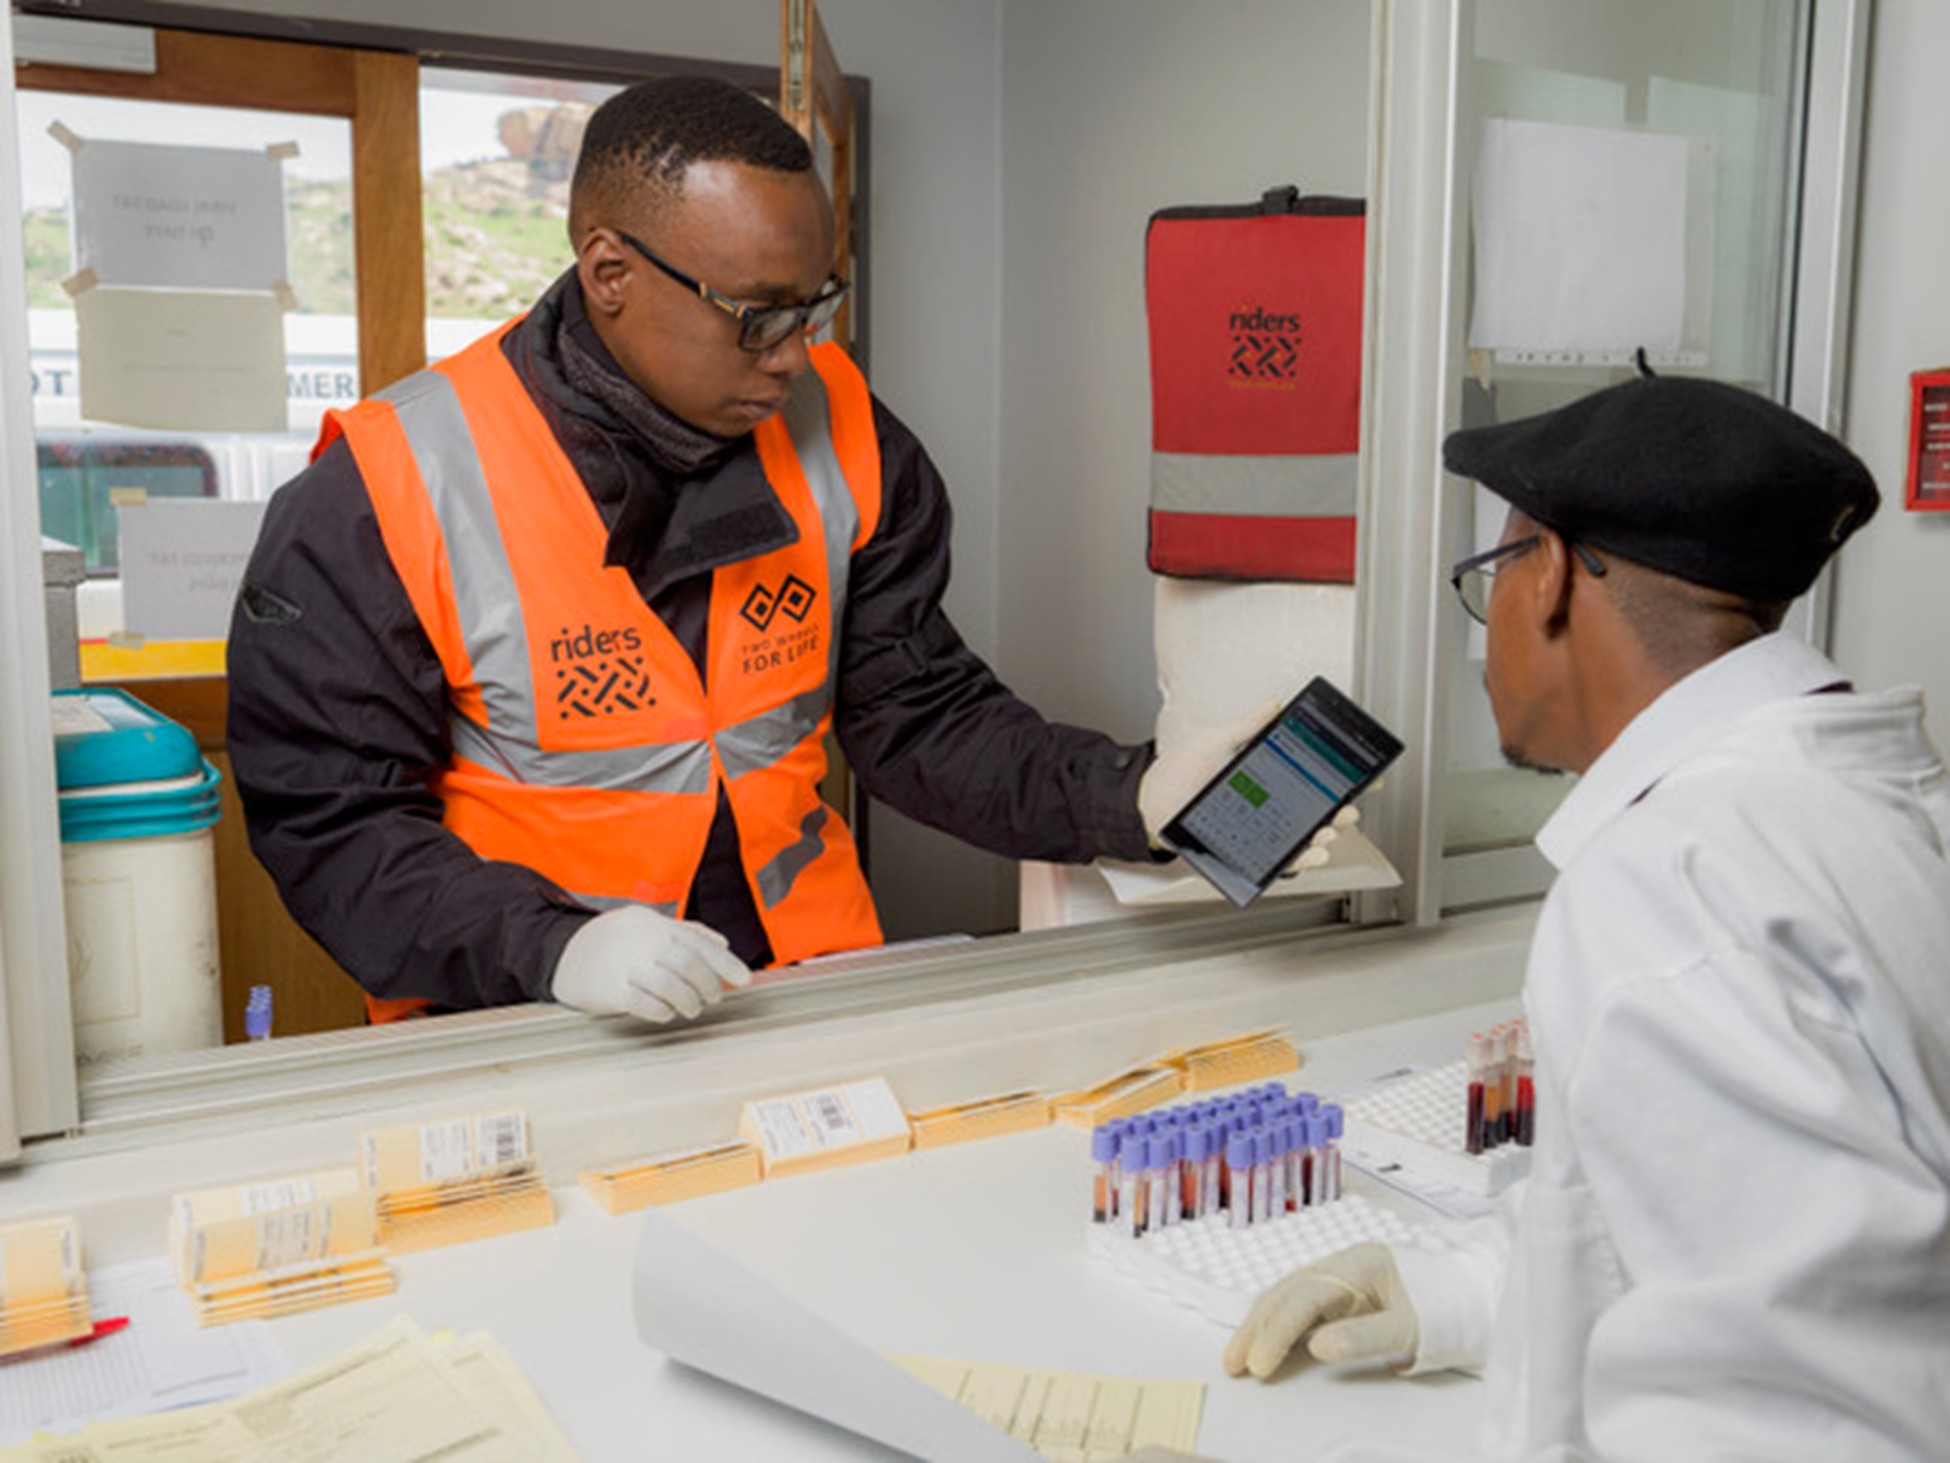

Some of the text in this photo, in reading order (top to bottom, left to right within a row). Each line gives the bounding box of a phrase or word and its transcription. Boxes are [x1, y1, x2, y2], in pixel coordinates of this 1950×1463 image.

[1230, 305, 1300, 333] riders
[551, 623, 642, 662] riders
[742, 633, 818, 675] FOR LIFE
